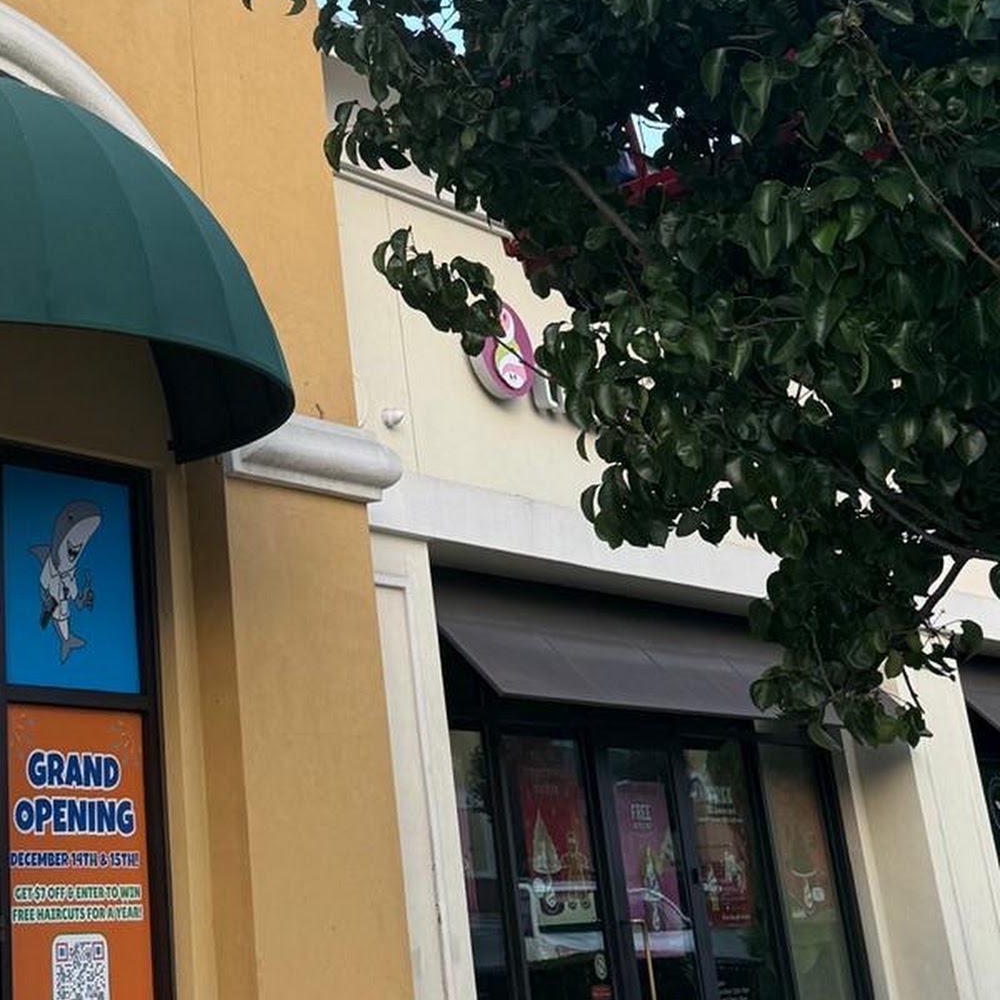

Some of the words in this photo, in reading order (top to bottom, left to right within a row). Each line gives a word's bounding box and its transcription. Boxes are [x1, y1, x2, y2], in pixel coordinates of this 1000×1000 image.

[27, 750, 120, 790] GRAND
[14, 797, 135, 836] OPENING
[630, 803, 652, 821] FREE
[9, 851, 68, 868] DECEMBER
[71, 851, 98, 868] 14TH
[110, 851, 139, 868] 15TH!
[15, 886, 32, 900] GET
[47, 886, 66, 900] OFF
[76, 886, 105, 899] ENTER
[106, 886, 119, 899] TO
[120, 886, 140, 899] WIN
[12, 908, 36, 922] FREE
[37, 907, 85, 921] HAIRCUTS
[87, 906, 105, 920] FOR
[107, 906, 115, 919] A
[115, 905, 142, 920] YEAR!
